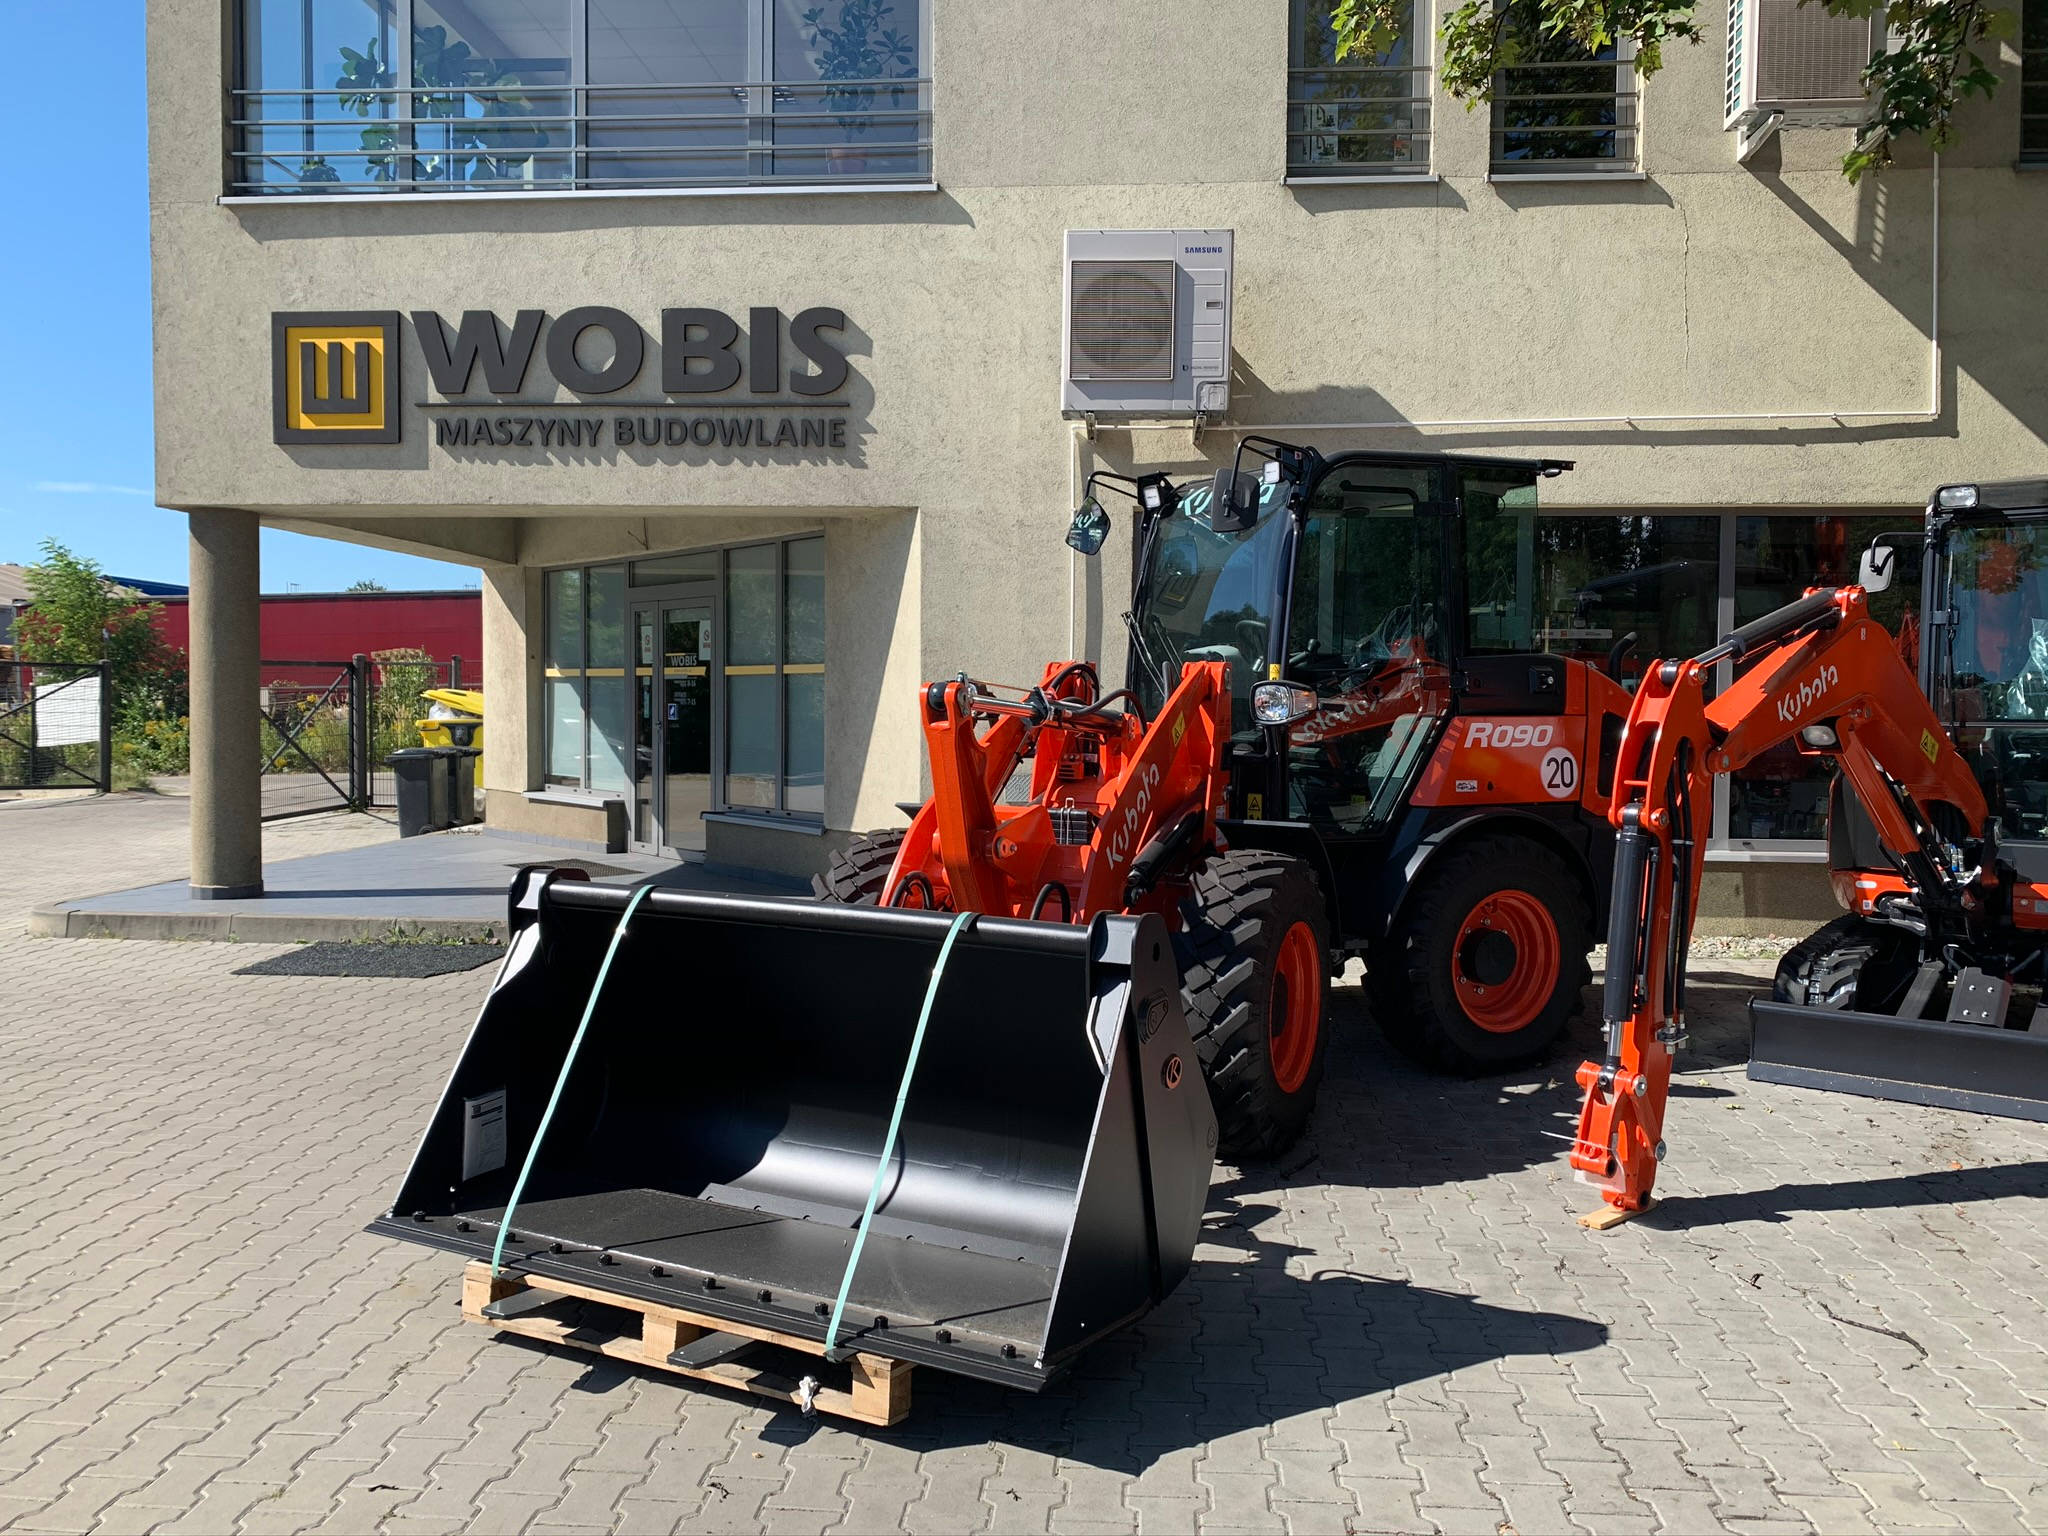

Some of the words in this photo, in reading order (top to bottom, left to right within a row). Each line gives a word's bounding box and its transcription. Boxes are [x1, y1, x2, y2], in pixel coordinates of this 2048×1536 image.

[1184, 246, 1223, 254] SAMSUNG
[410, 305, 848, 396] WOBIS
[436, 417, 603, 447] MASZYNY
[614, 417, 847, 447] BUDOWLANE
[671, 656, 697, 666] WOBIS
[1777, 665, 1838, 721] Kubota
[1464, 722, 1553, 748] R090
[1546, 756, 1574, 788] 20
[1106, 763, 1160, 871] Kubota
